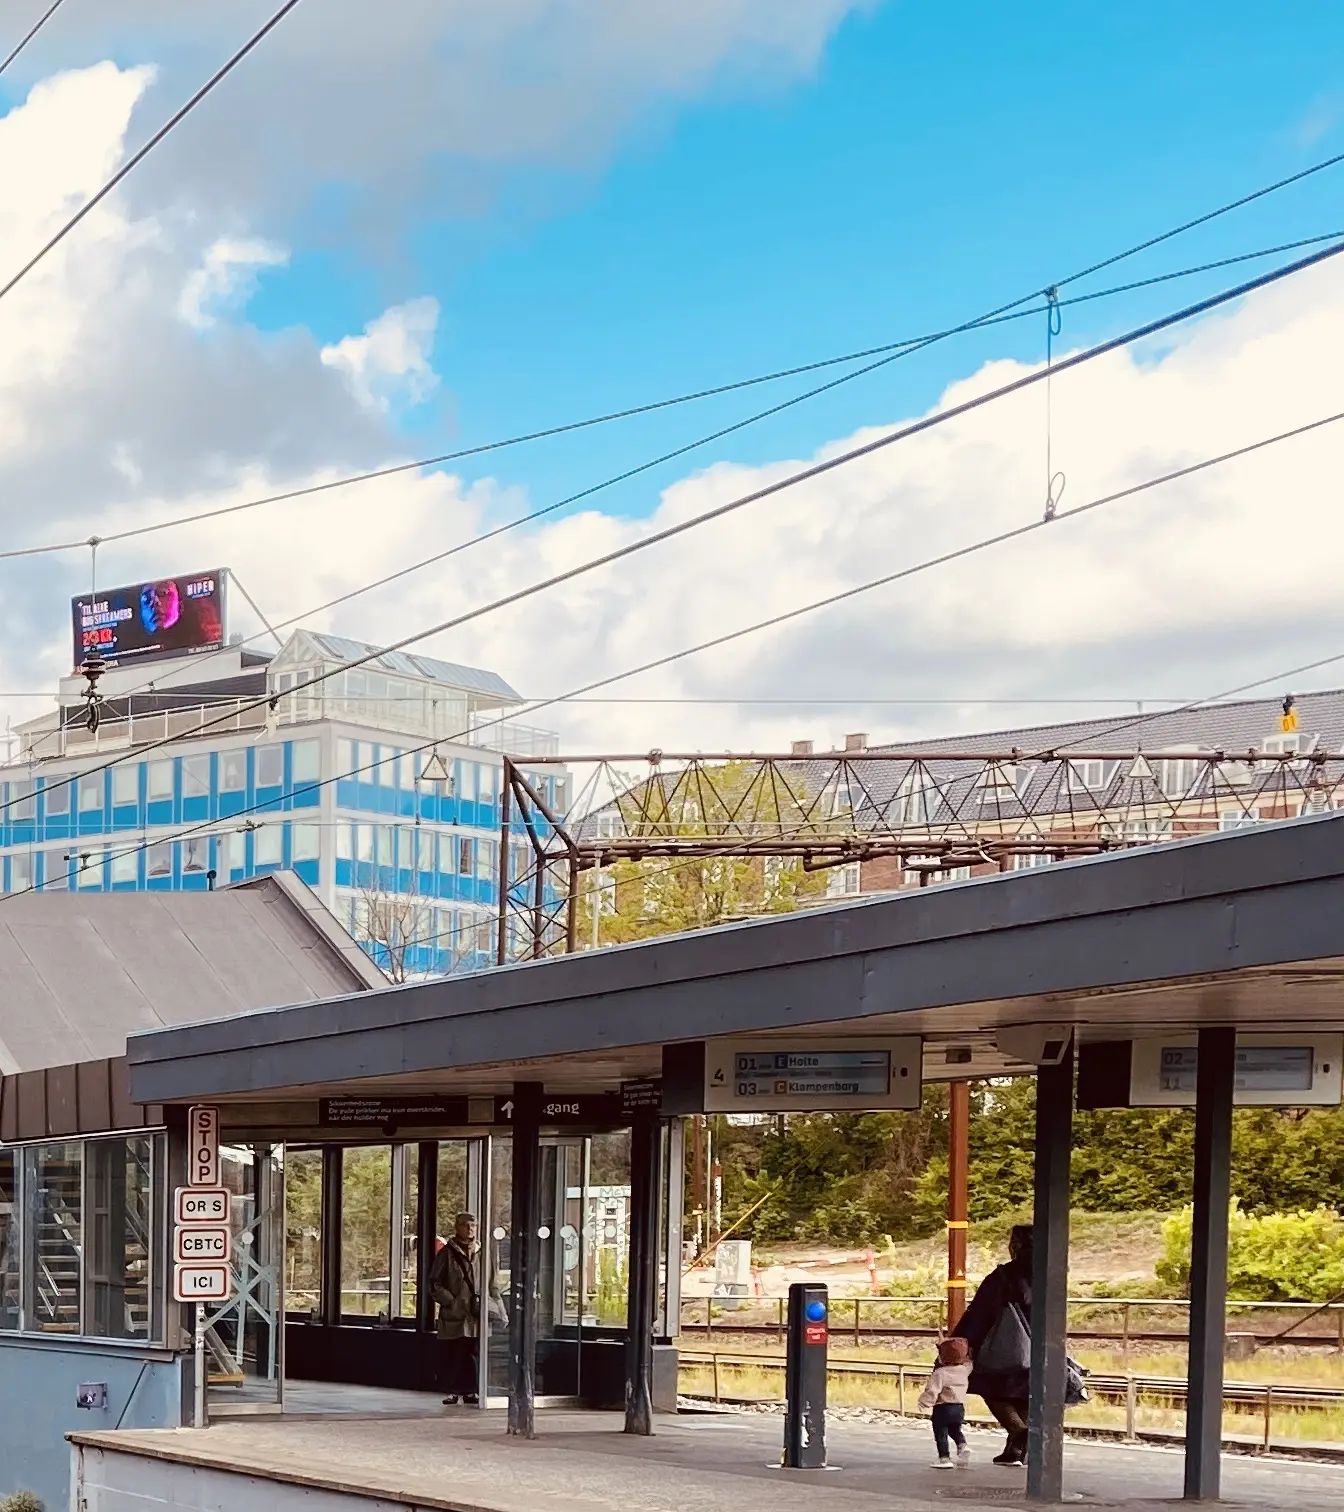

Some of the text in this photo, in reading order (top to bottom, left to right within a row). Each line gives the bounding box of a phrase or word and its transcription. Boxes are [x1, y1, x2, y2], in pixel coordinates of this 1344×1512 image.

[187, 579, 215, 596] HIPER
[738, 1057, 758, 1071] 01
[789, 1056, 819, 1067] Holte
[714, 1068, 725, 1082] 4
[738, 1082, 757, 1096] 03
[789, 1081, 860, 1094] Klampenborg
[545, 1102, 580, 1116] gang
[198, 1112, 212, 1182] STOP
[186, 1200, 223, 1212] OR S
[183, 1238, 224, 1251] CBTC
[193, 1276, 213, 1288] ICI
